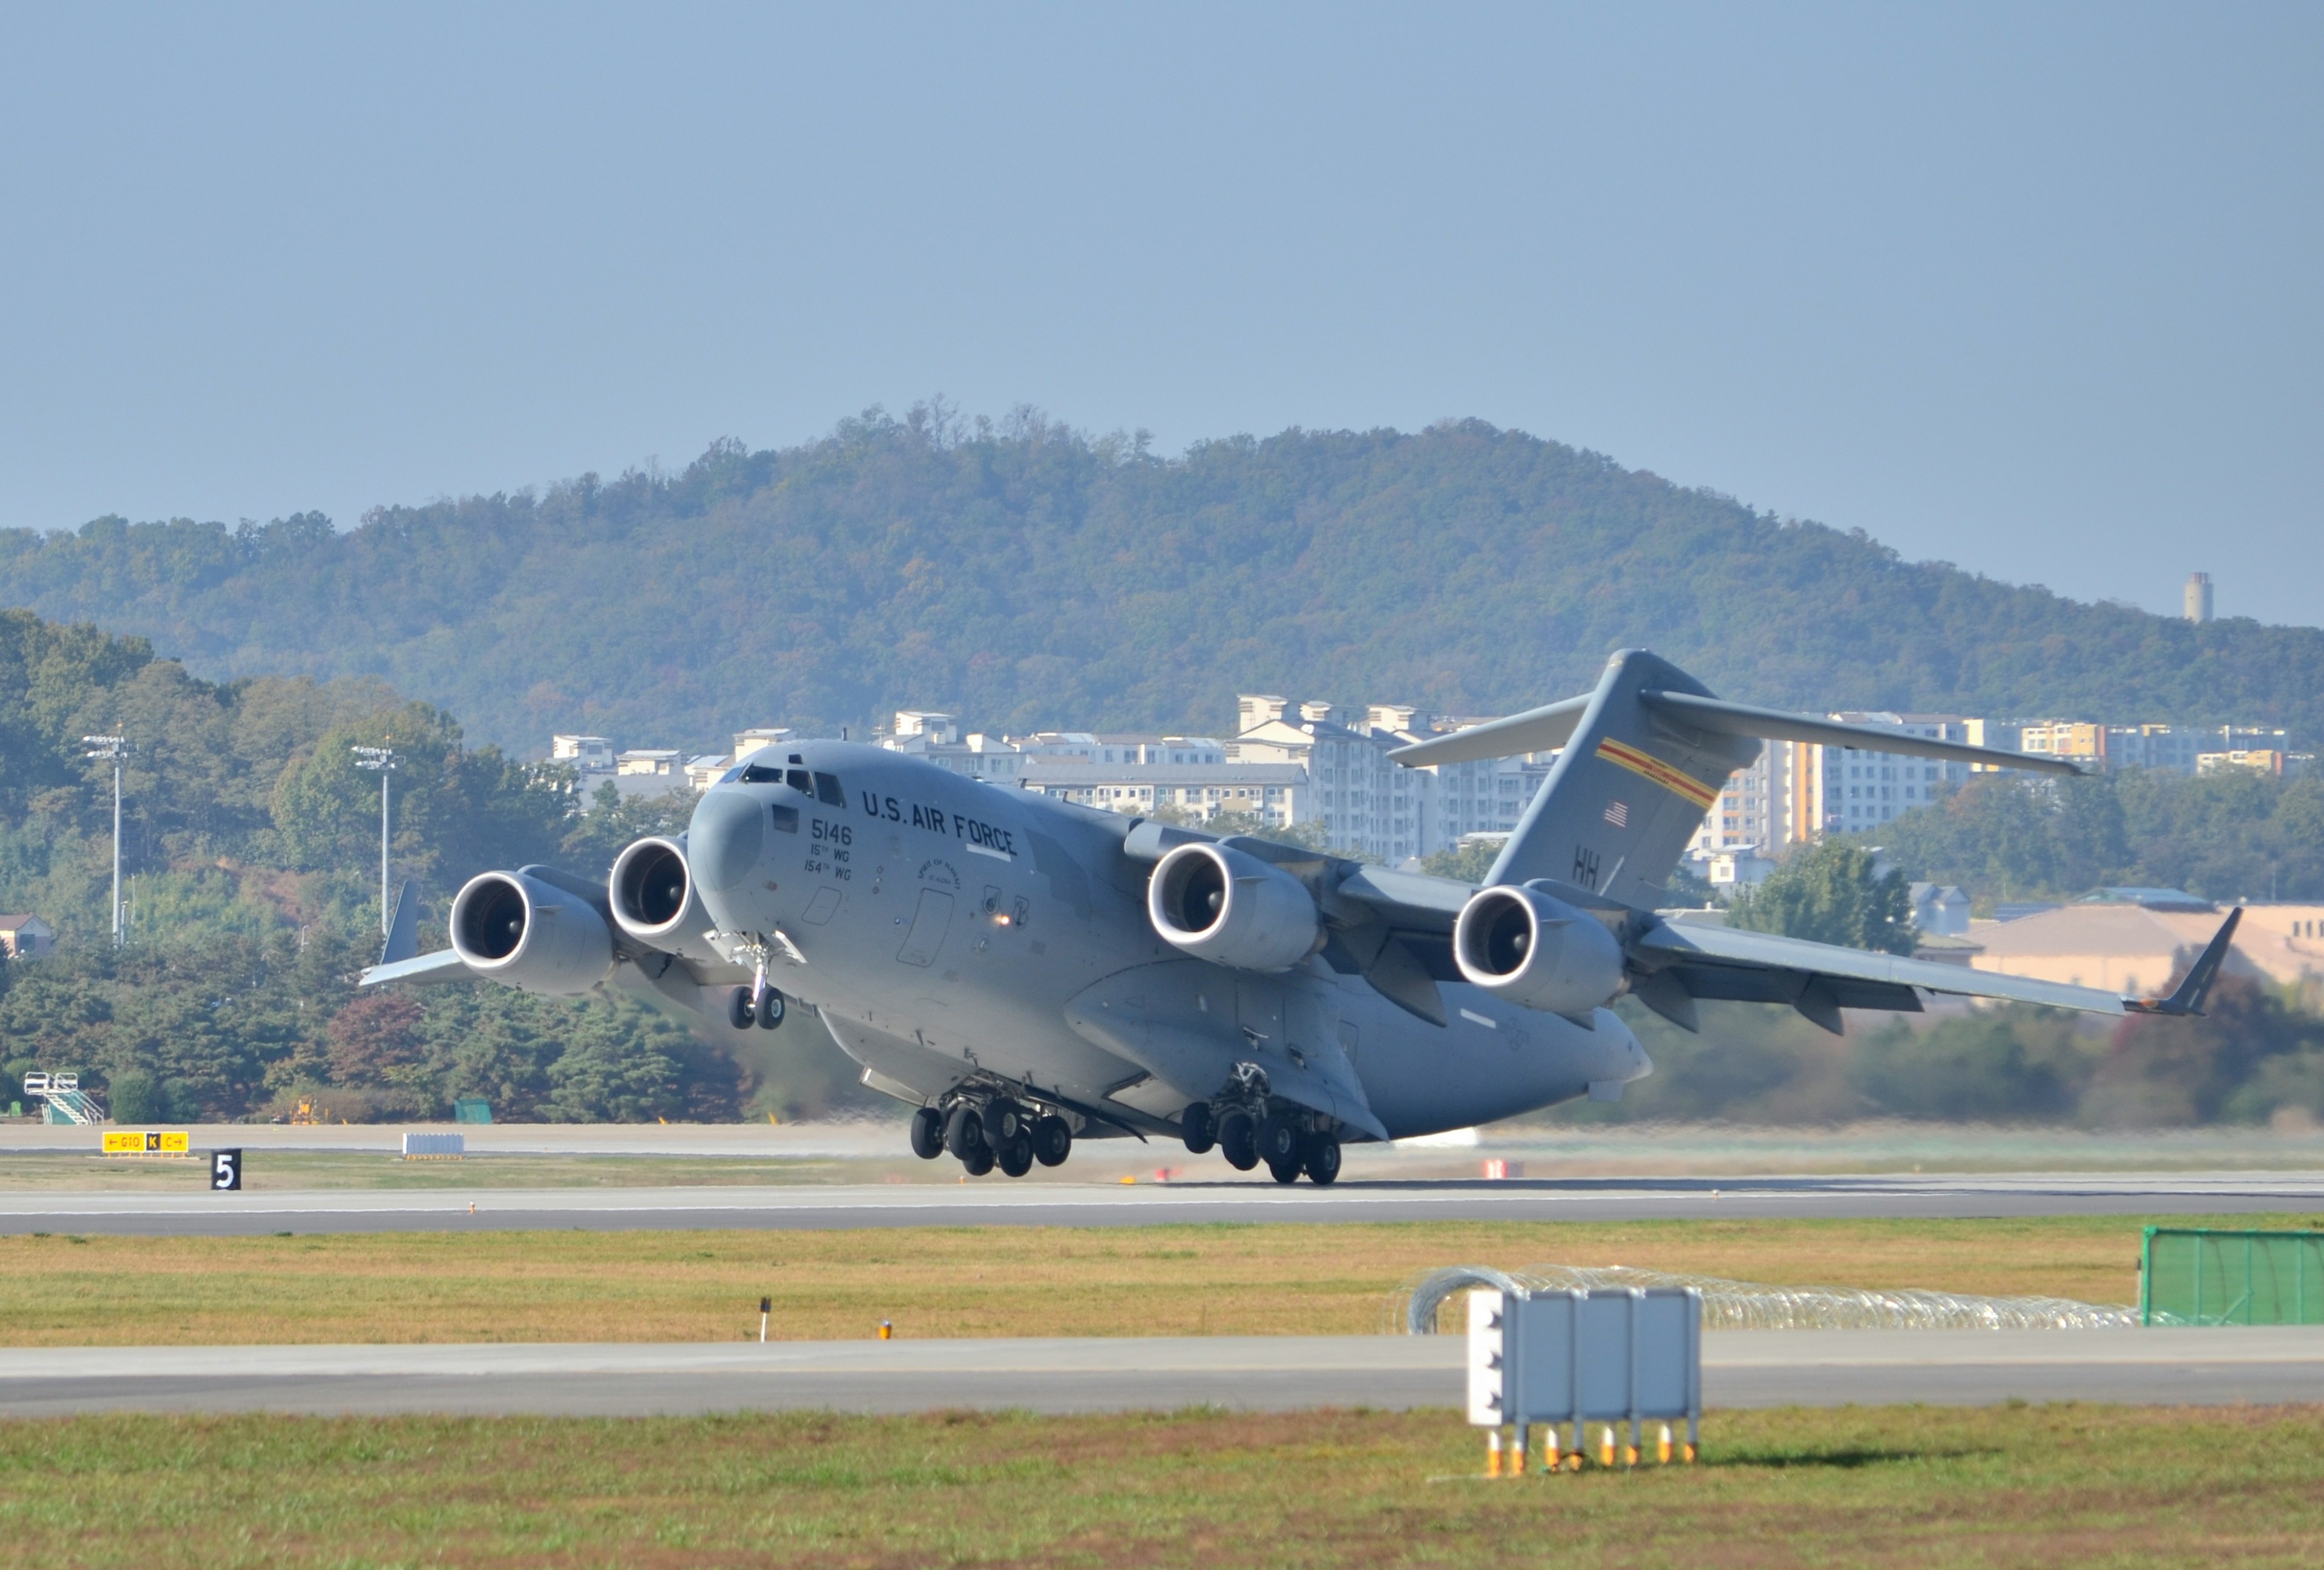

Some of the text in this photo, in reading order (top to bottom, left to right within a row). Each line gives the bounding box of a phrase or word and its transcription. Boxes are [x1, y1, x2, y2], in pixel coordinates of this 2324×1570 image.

[812, 818, 852, 846] 5146
[862, 791, 1017, 856] U.S. AIR FORCE
[834, 847, 850, 862] WG
[1572, 844, 1601, 891] HH
[835, 866, 852, 881] WG
[121, 1136, 172, 1148] G10 K C
[216, 1154, 234, 1188] 5
